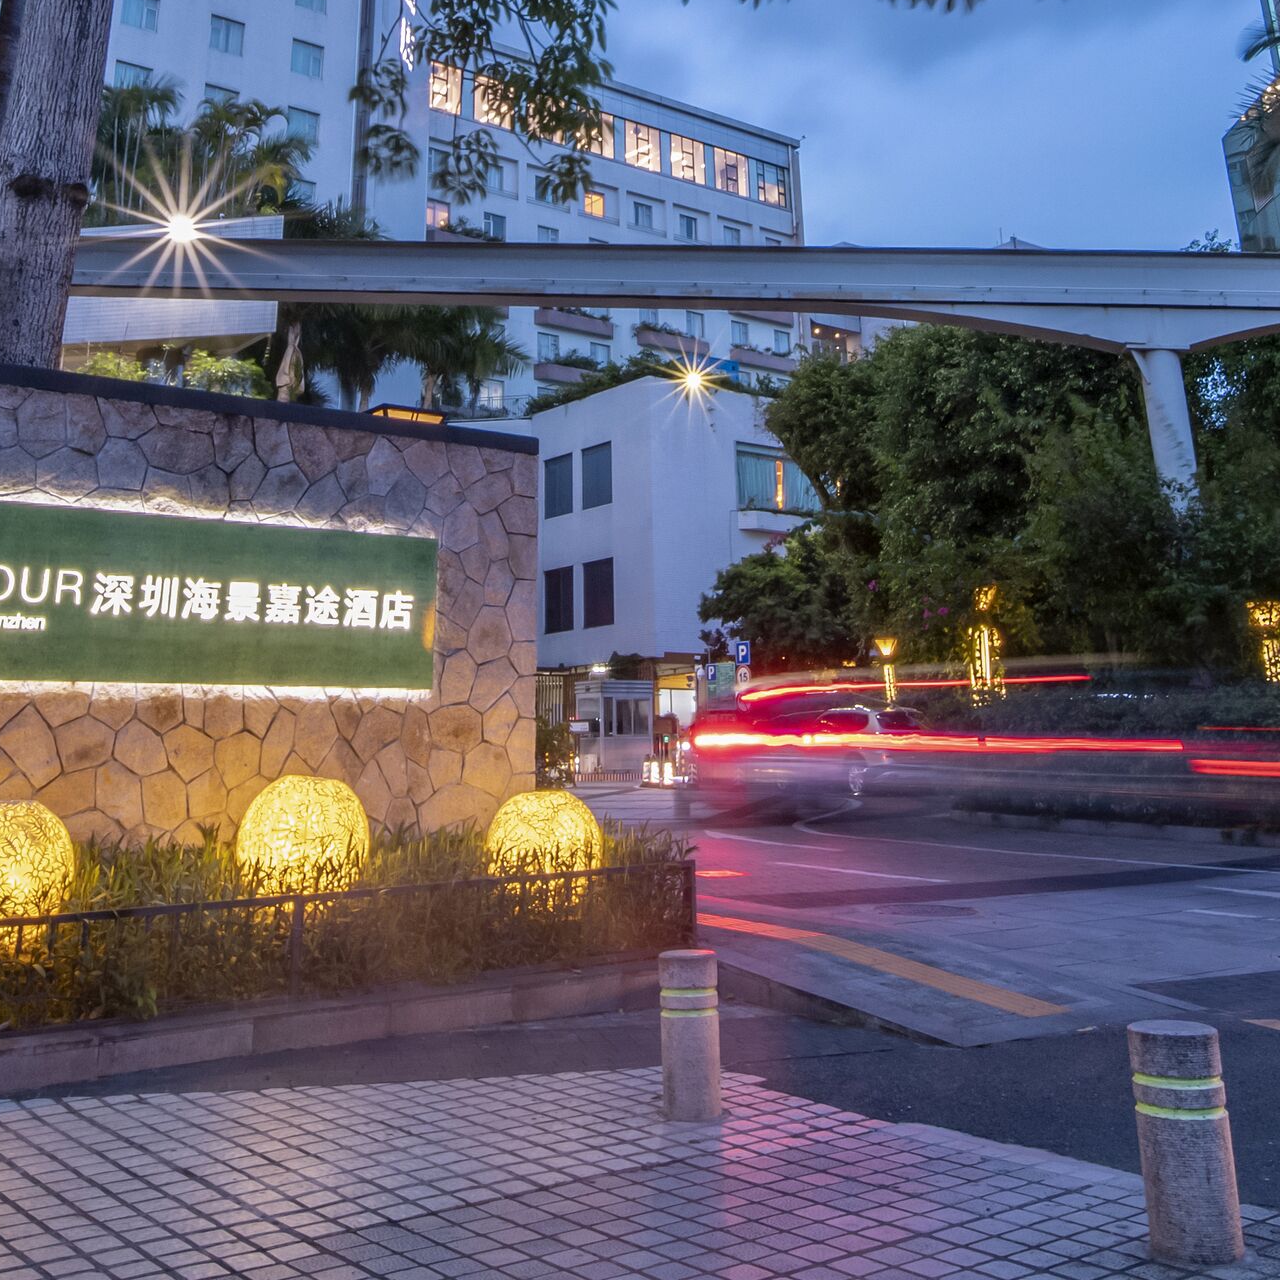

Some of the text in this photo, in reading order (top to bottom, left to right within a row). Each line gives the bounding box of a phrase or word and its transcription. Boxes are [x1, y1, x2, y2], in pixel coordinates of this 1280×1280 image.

[89, 571, 416, 631] 深圳海景嘉途酒店
[738, 645, 747, 662] P
[708, 666, 715, 680] P
[739, 671, 748, 682] 15
